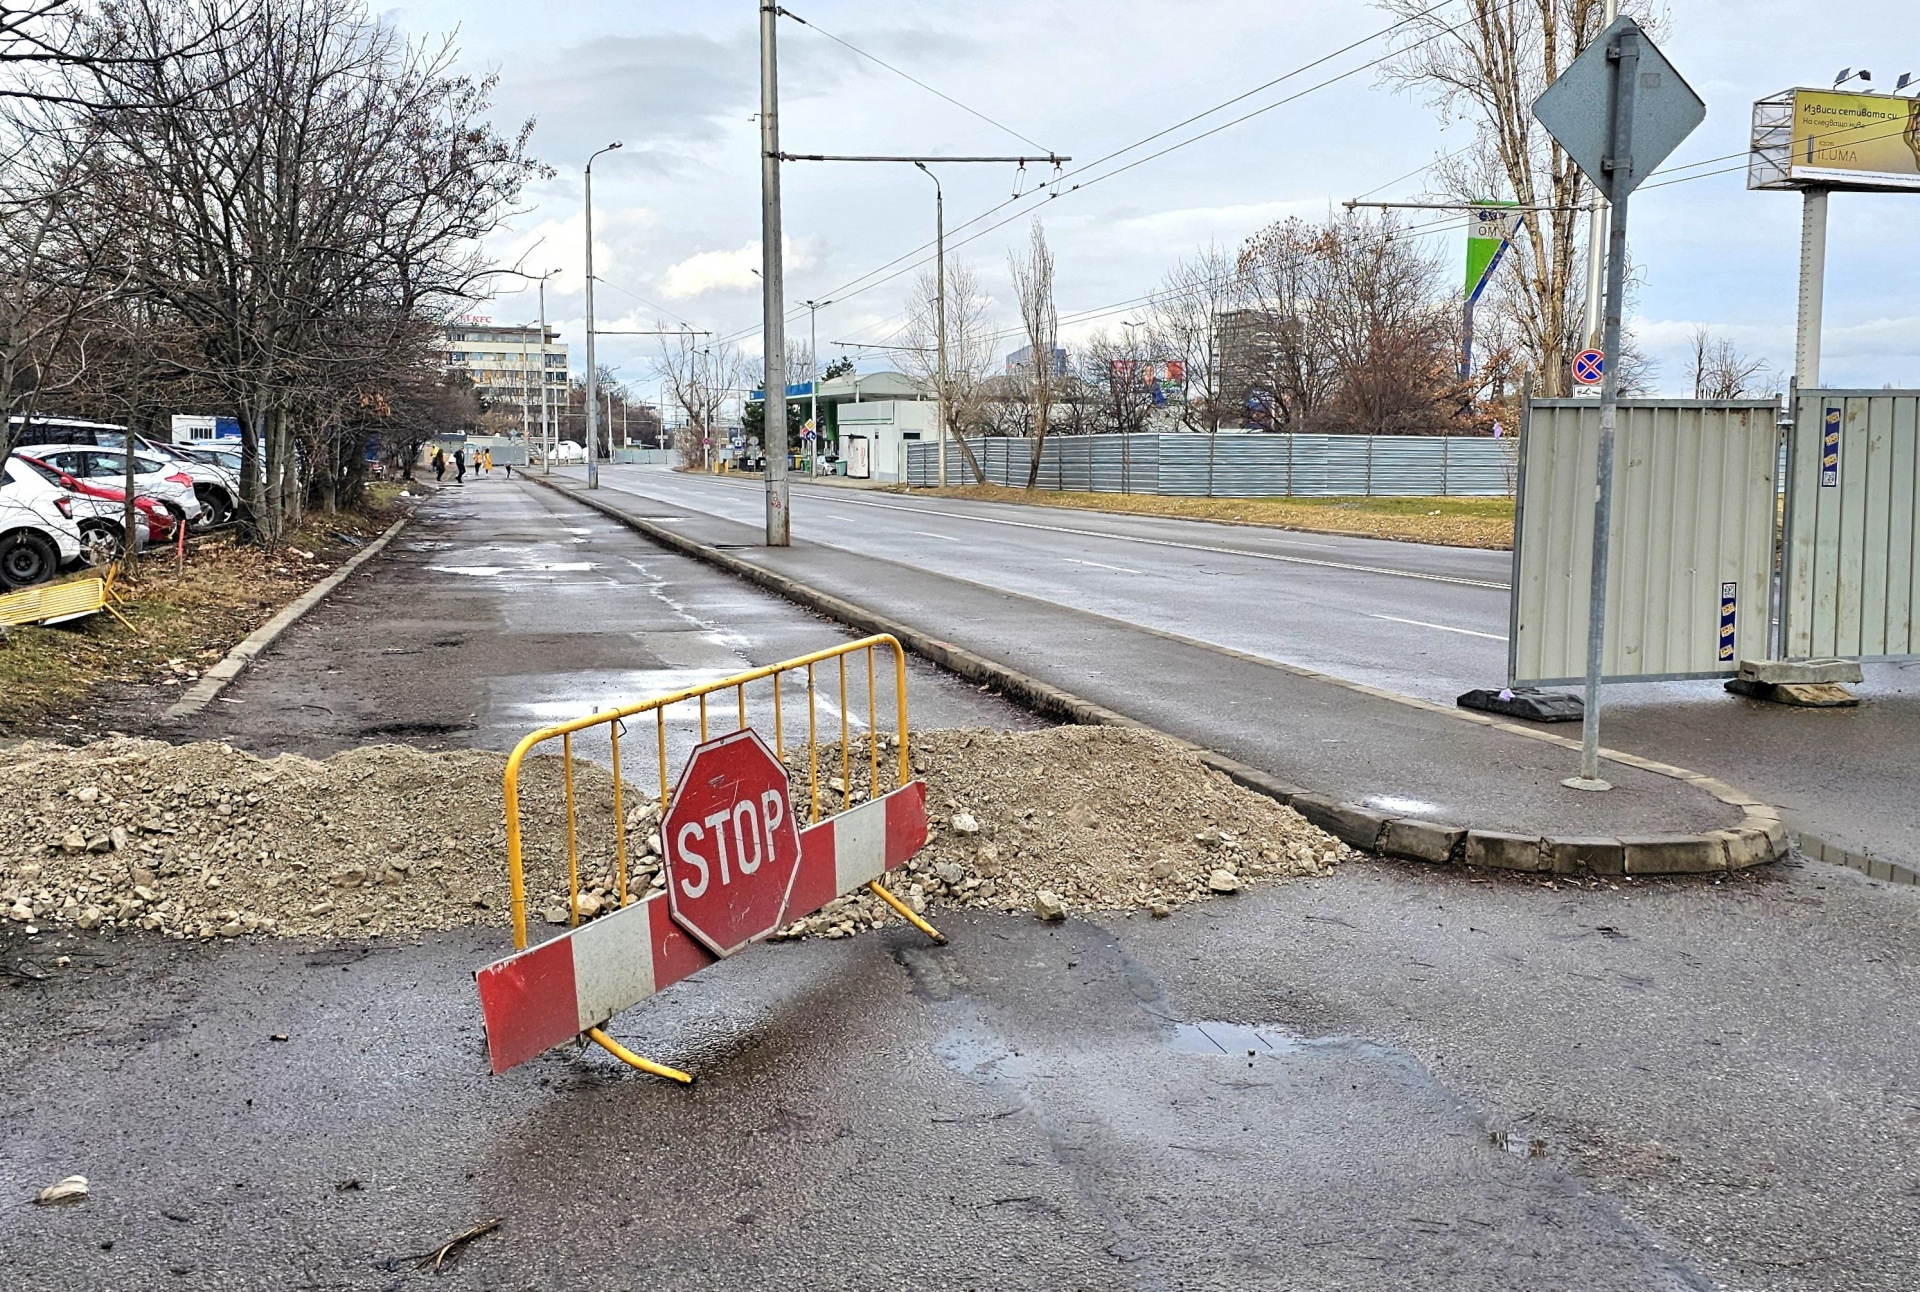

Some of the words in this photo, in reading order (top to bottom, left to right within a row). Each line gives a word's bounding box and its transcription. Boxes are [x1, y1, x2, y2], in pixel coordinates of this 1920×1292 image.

[1804, 103, 1837, 115] Извиси
[1838, 108, 1886, 118] сетивата
[1803, 117, 1812, 125] На
[1818, 149, 1857, 162] ILUMA
[677, 789, 784, 899] STOP
